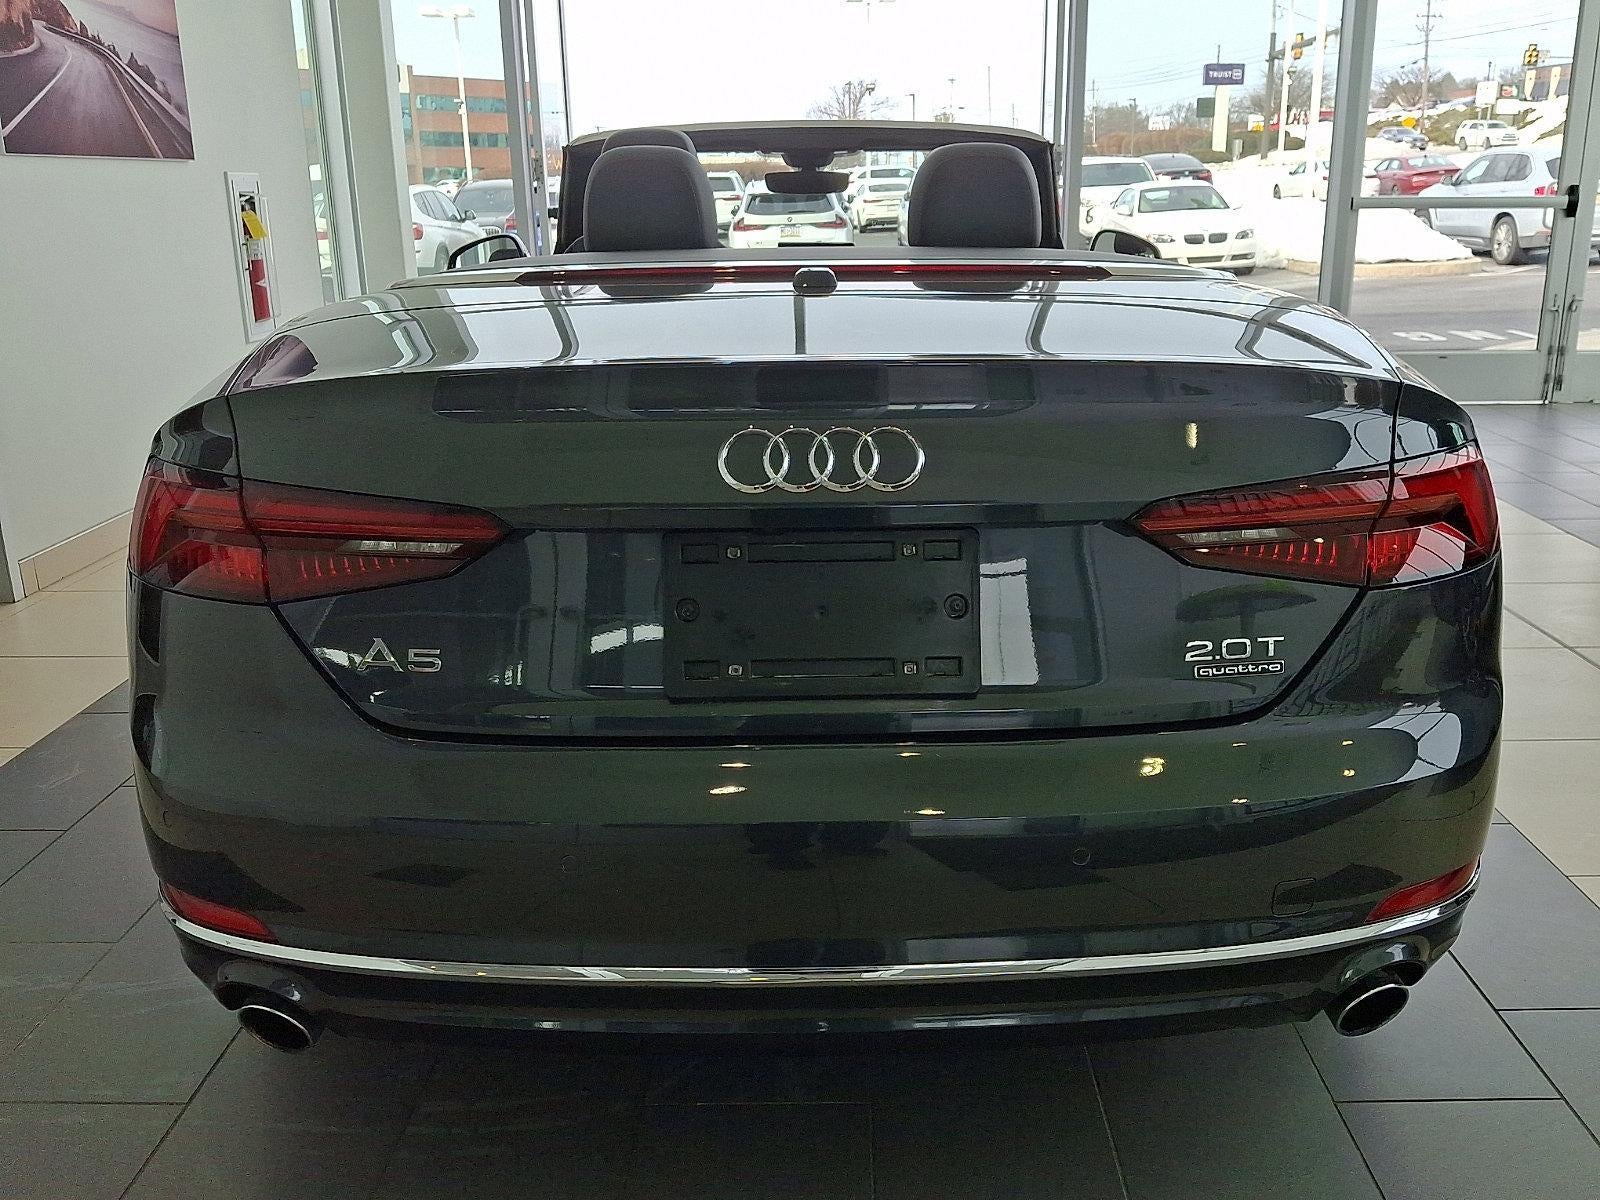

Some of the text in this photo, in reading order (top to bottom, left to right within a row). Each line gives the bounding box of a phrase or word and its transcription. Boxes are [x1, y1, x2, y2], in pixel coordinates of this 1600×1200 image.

[1209, 70, 1232, 78] TRUIST
[357, 637, 442, 673] A5
[1199, 663, 1281, 677] quattro
